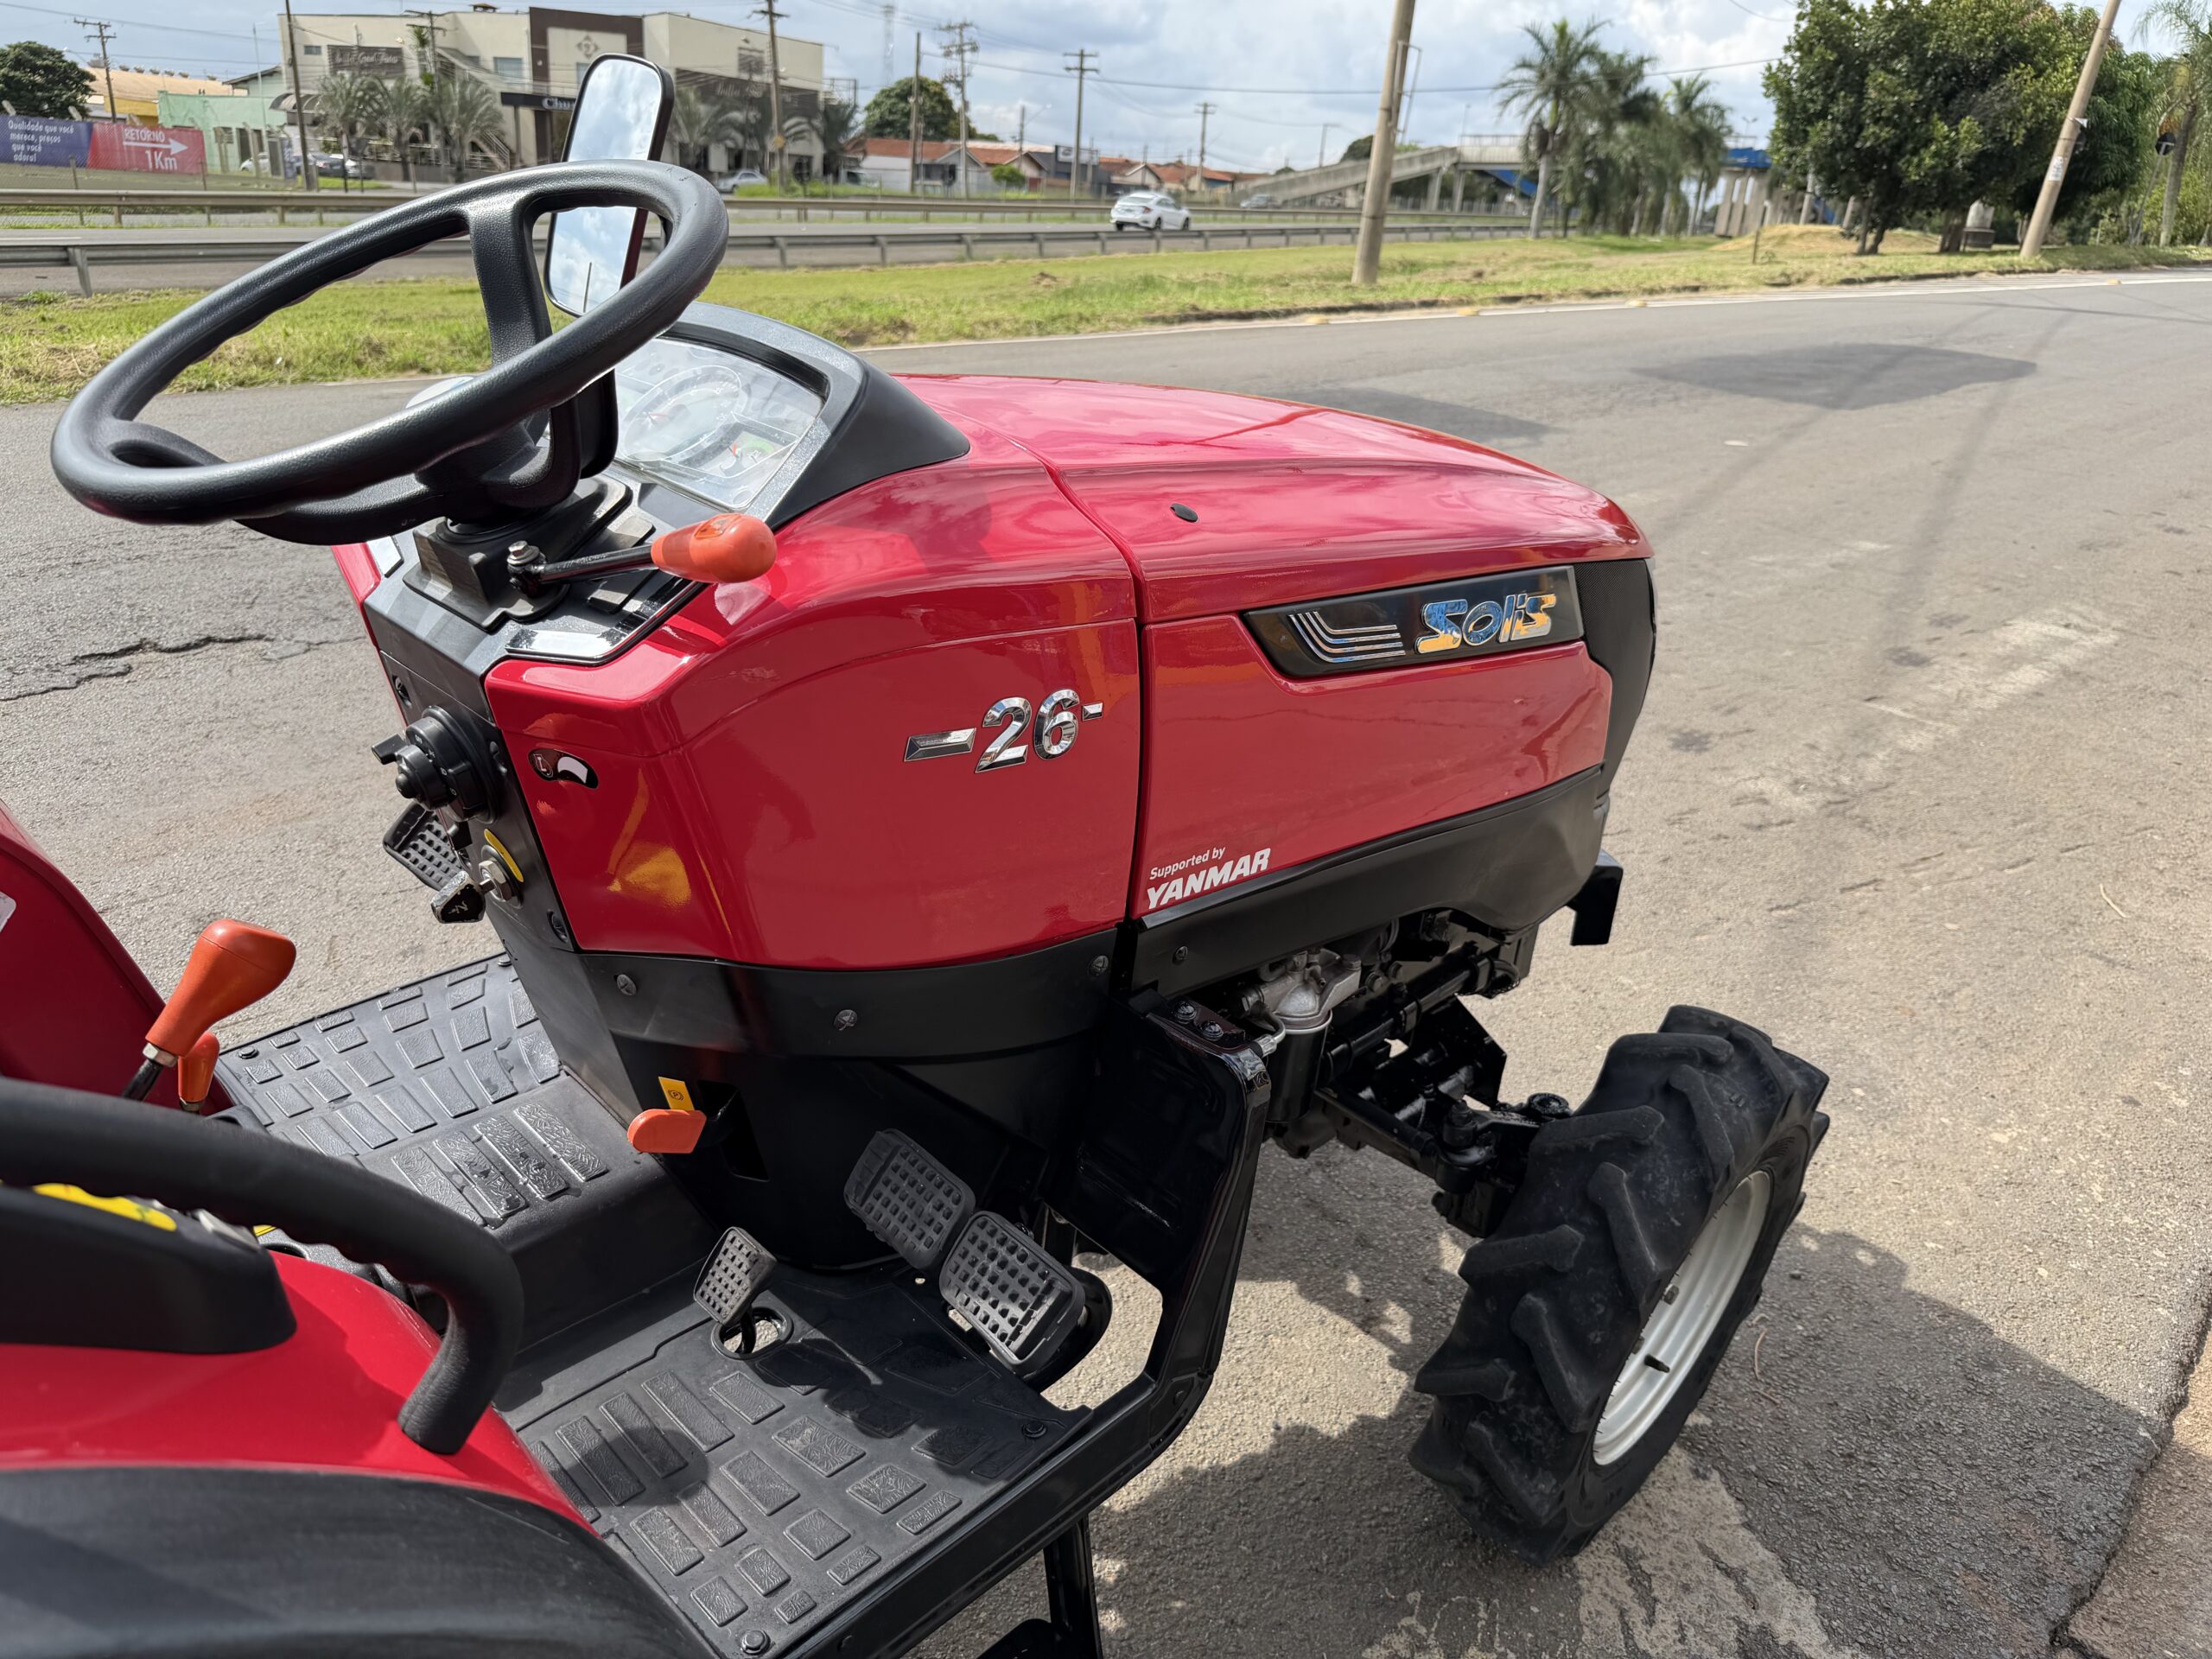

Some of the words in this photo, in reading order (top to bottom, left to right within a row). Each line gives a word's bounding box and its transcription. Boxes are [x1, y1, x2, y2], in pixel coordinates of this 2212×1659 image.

[8, 119, 44, 131] Qualidade
[44, 124, 58, 134] que
[58, 124, 75, 134] você
[10, 132, 38, 143] merece,
[38, 135, 61, 145] preços
[124, 128, 166, 143] RETORNO
[11, 143, 26, 152] que
[26, 142, 42, 152] você
[975, 688, 1080, 774] 26
[1149, 849, 1210, 880] Supported
[1211, 846, 1226, 861] by
[1145, 847, 1272, 912] YANMAR
